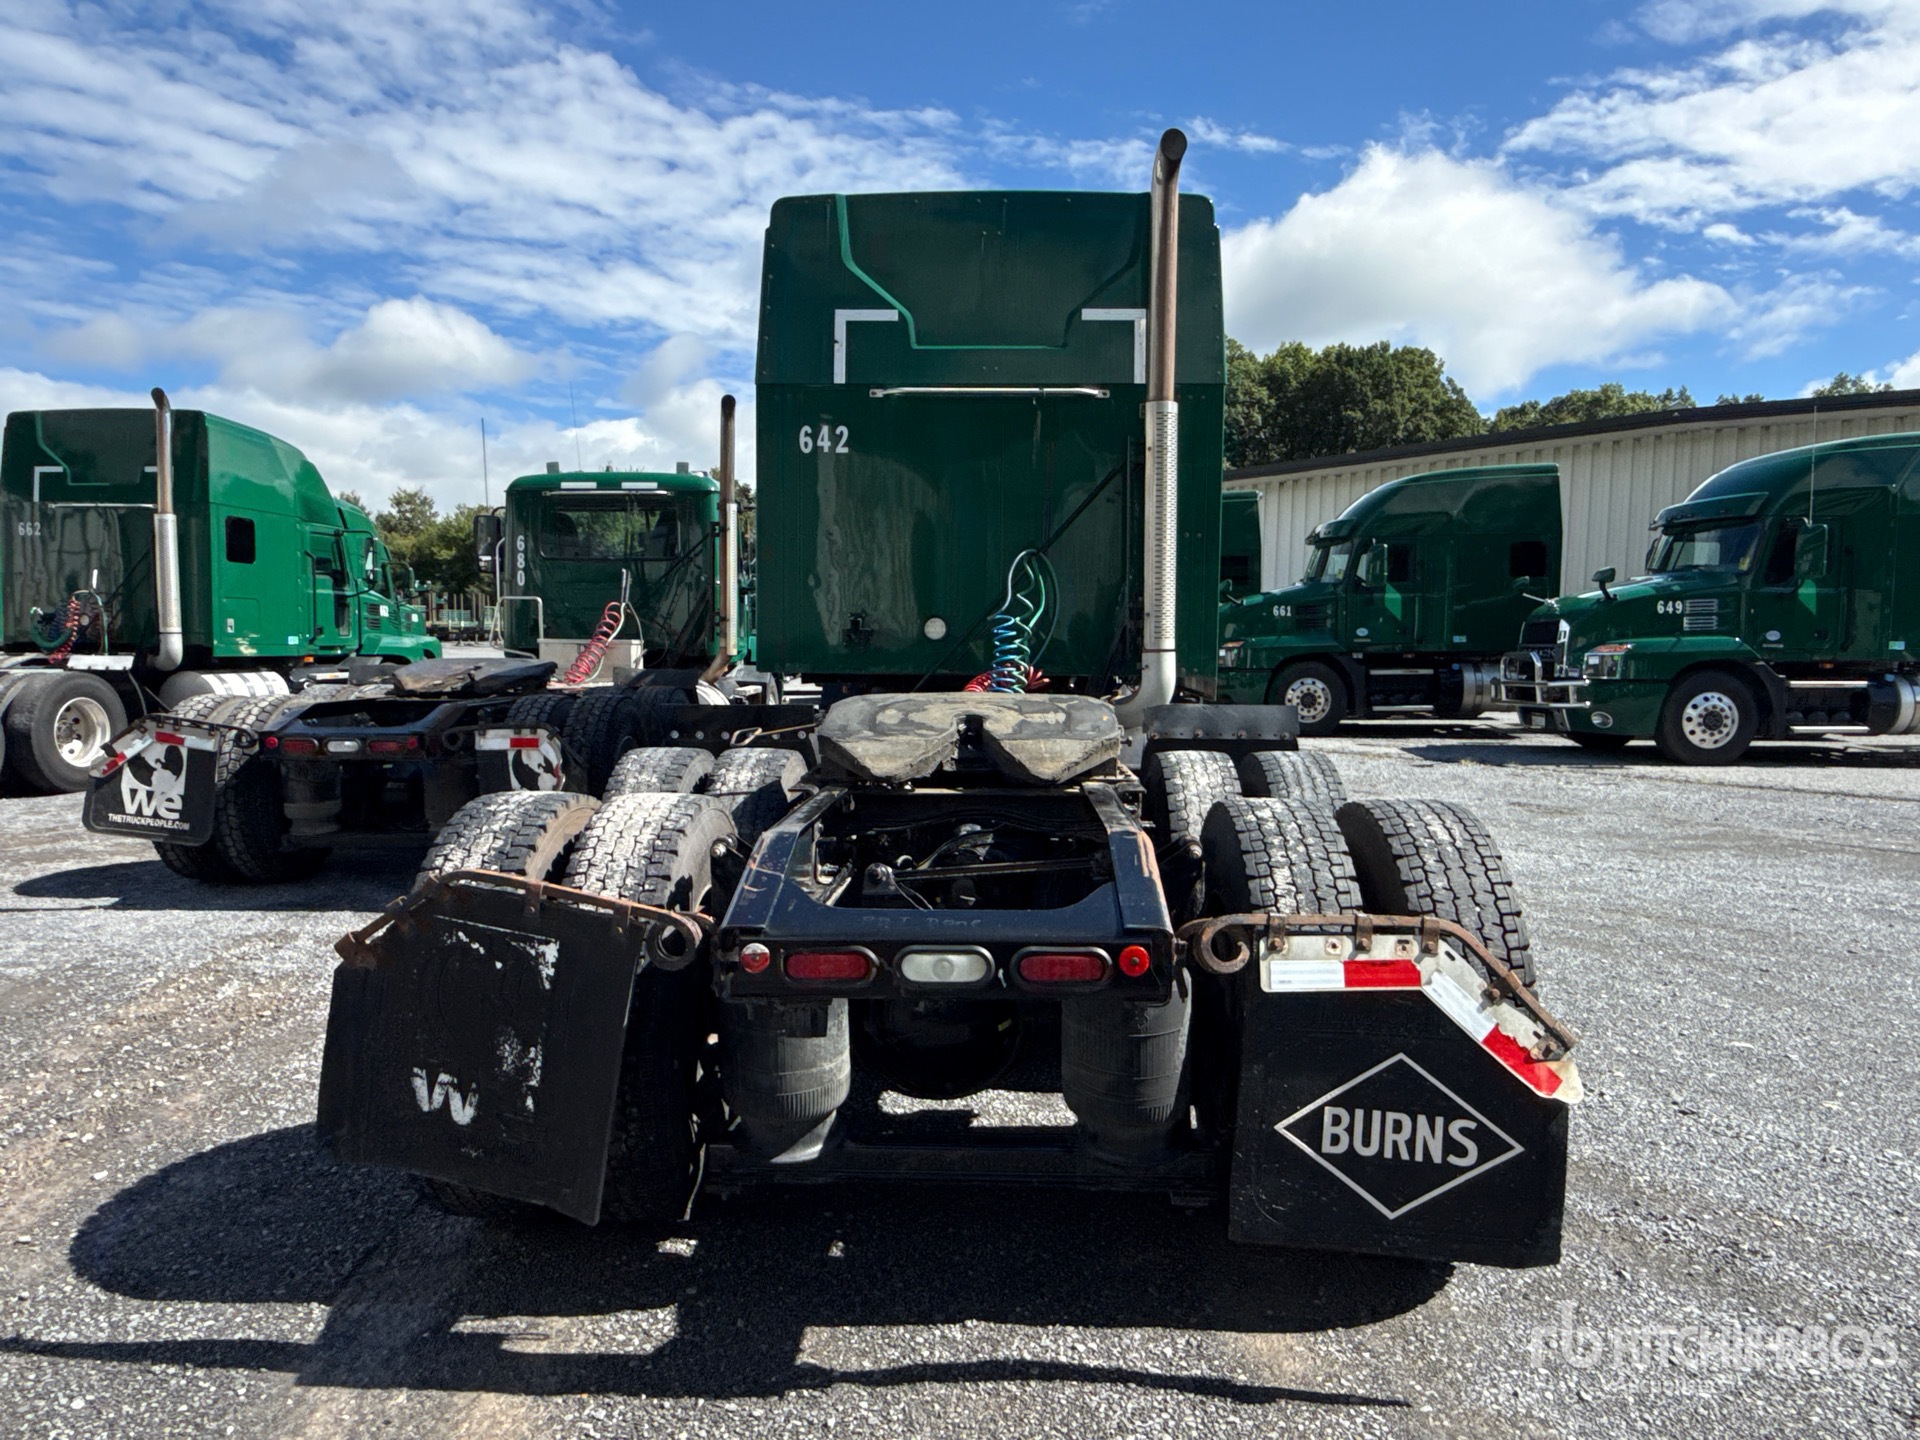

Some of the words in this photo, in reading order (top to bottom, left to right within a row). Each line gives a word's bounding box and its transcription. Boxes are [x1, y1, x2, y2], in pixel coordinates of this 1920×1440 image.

[798, 424, 849, 454] 642
[18, 521, 42, 536] 662
[516, 534, 526, 587] 680
[1272, 604, 1292, 617] 661
[1656, 600, 1683, 615] 649
[107, 812, 191, 831] THETRUCKPEOPLE.COM
[1320, 1105, 1479, 1167] BURNS
